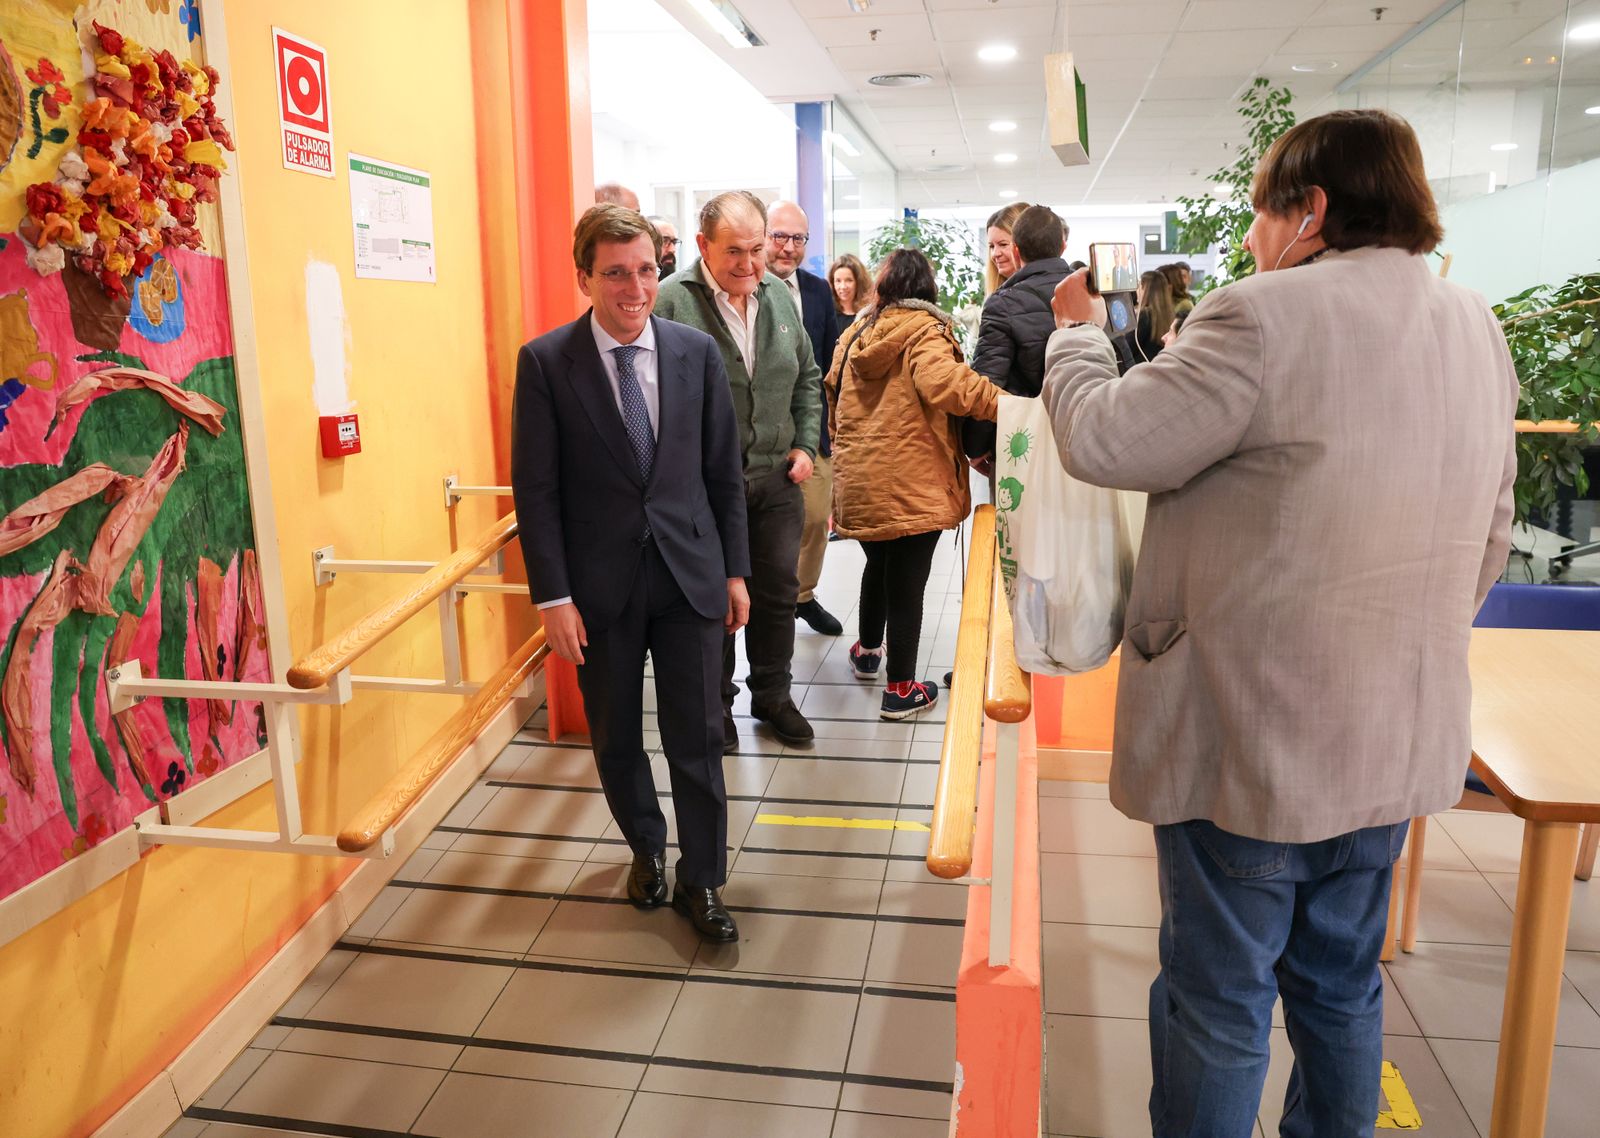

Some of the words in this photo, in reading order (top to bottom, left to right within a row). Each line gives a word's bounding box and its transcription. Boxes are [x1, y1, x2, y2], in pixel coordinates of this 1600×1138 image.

[286, 132, 329, 156] PULSADOR
[287, 147, 299, 163] DE
[300, 151, 330, 170] ALARMA
